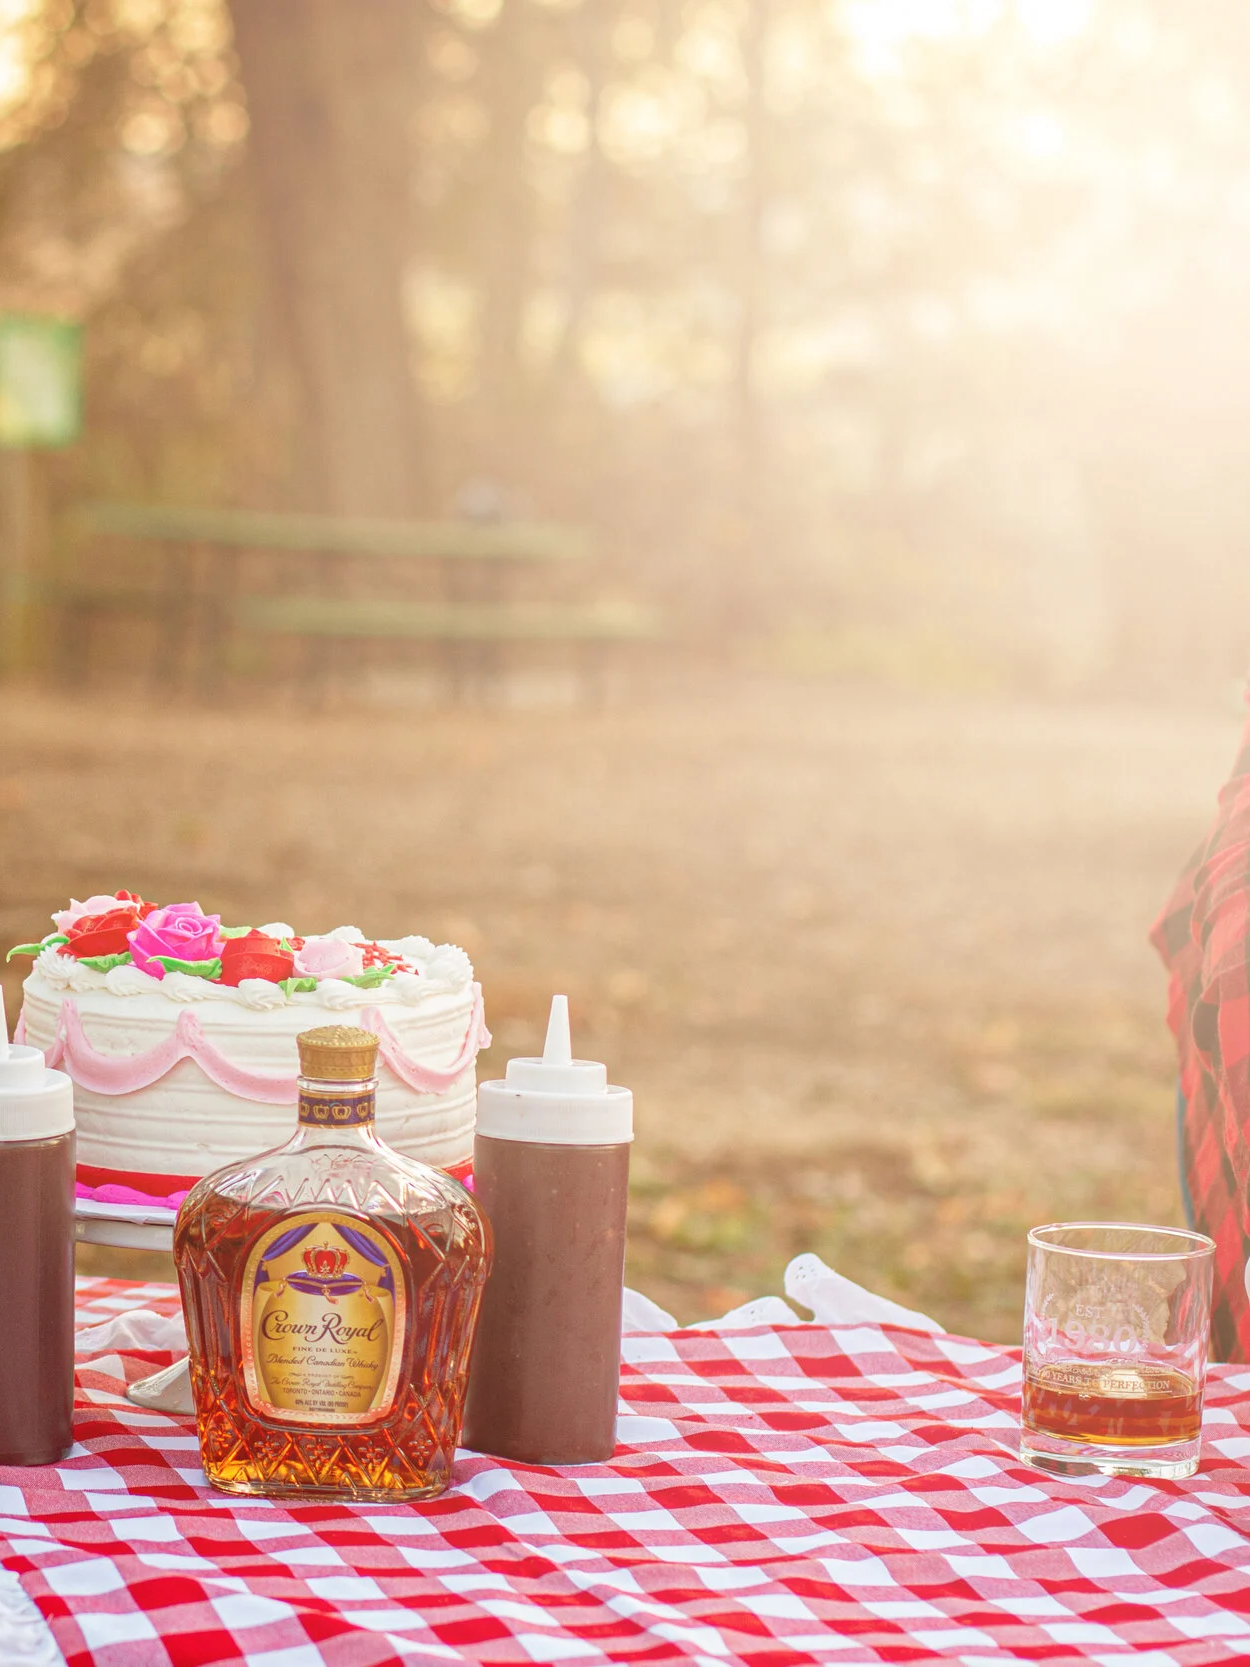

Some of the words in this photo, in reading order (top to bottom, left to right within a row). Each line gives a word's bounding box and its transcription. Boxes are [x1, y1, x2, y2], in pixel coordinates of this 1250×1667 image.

[261, 1309, 317, 1341] Crown
[305, 1312, 384, 1345] Royal
[1045, 1317, 1139, 1353] 1980
[265, 1353, 306, 1366] Blended
[306, 1355, 346, 1367] Canadian
[1052, 1371, 1082, 1385] YEARS
[283, 1387, 308, 1395] TORONTO
[311, 1388, 335, 1396] ONTARIO
[338, 1390, 361, 1398] CANADA
